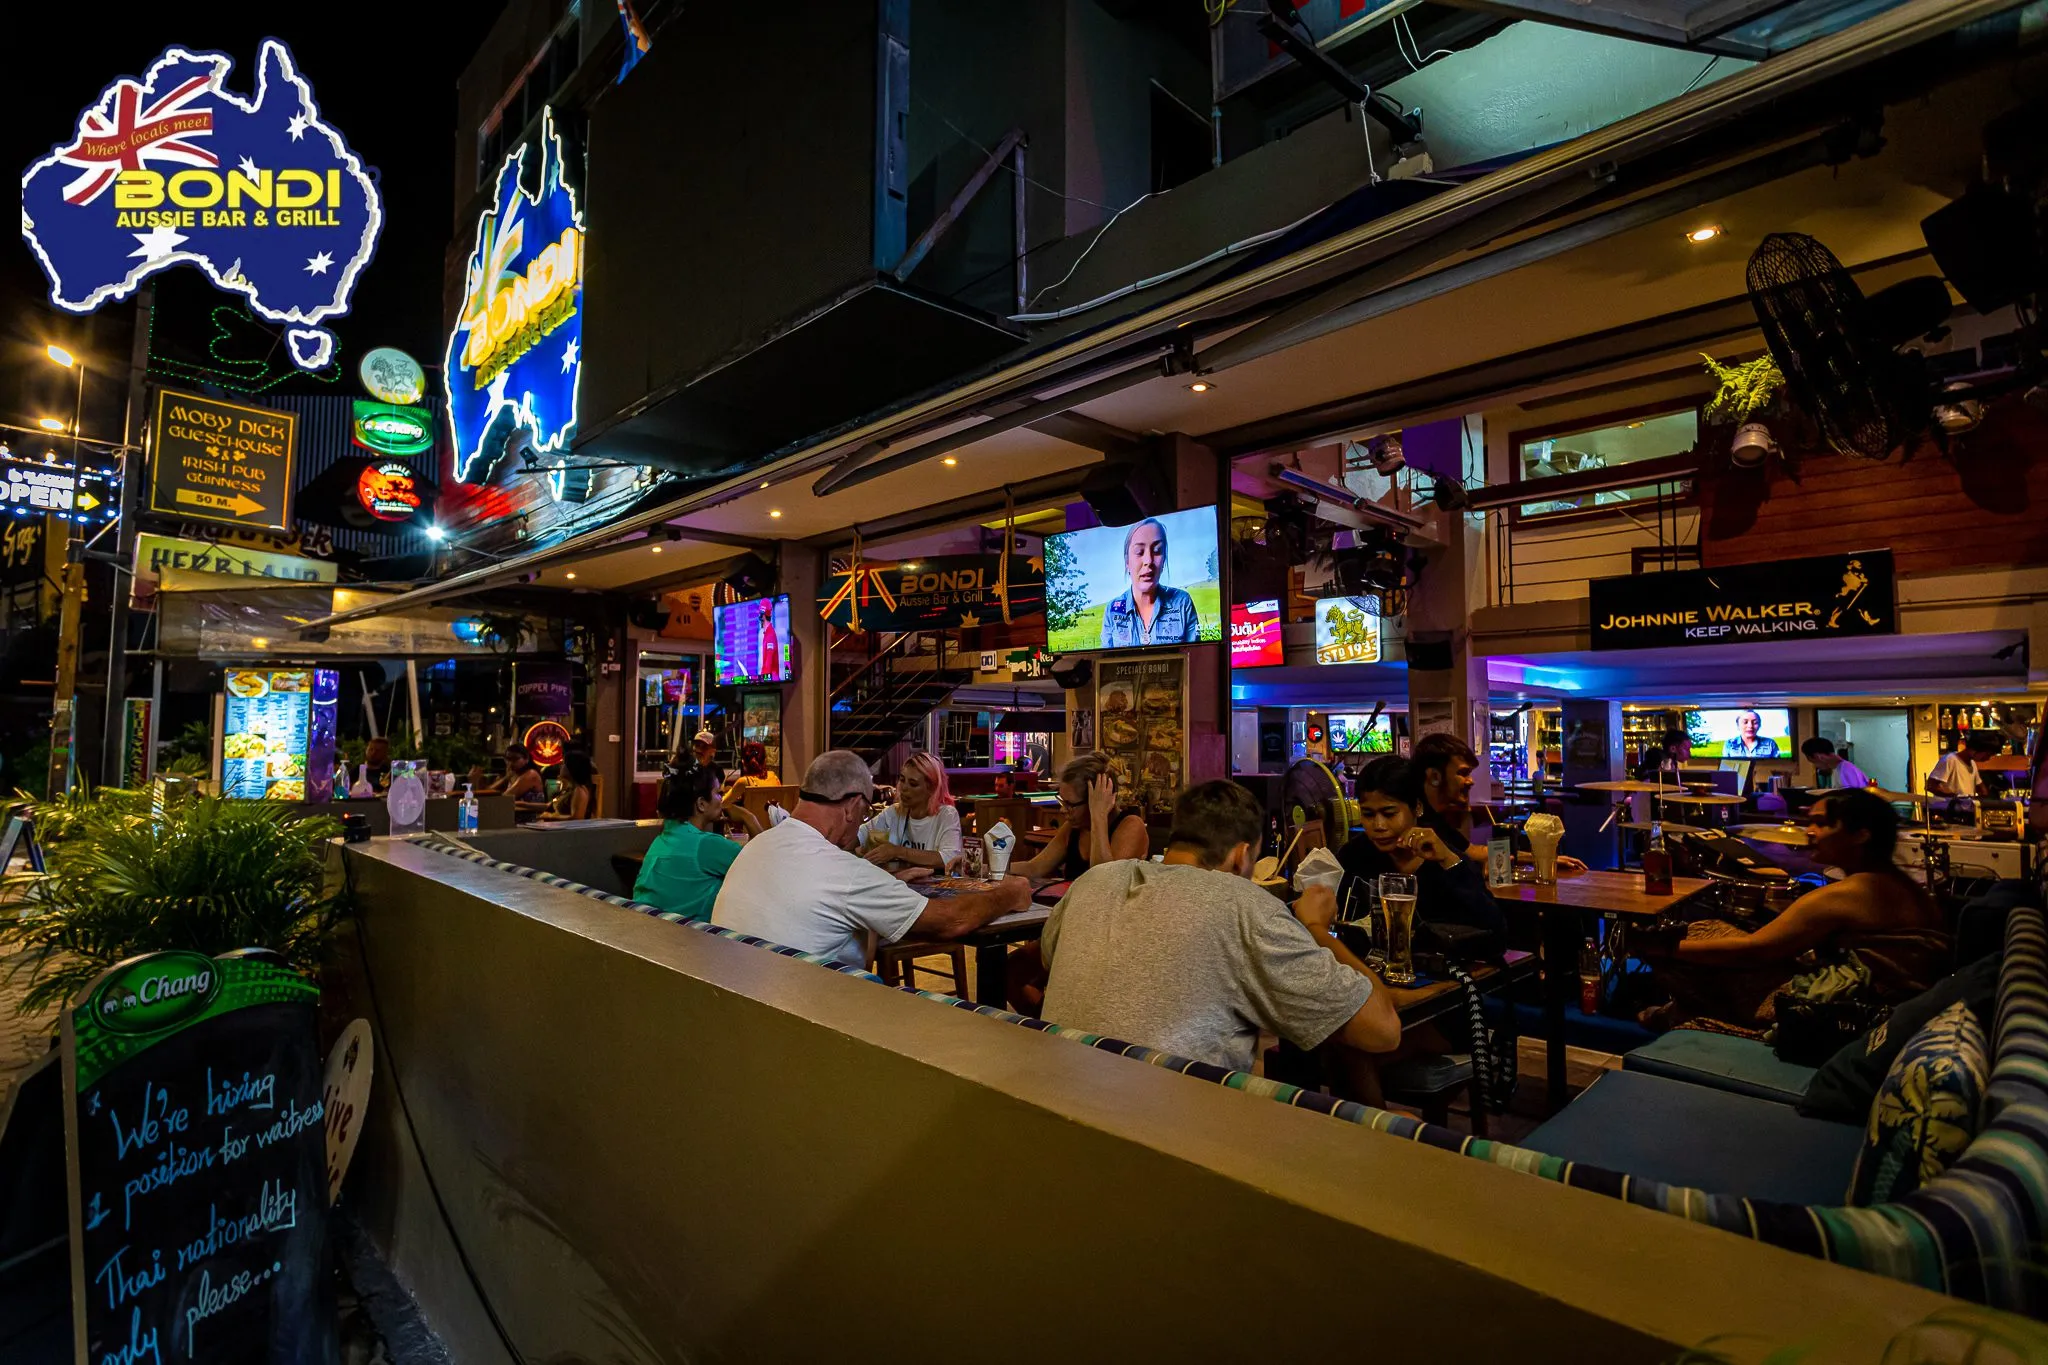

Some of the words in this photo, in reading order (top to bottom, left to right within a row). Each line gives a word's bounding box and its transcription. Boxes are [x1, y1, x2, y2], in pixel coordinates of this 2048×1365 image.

[83, 140, 127, 158] Where
[130, 119, 169, 147] locals
[174, 115, 209, 132] meet
[114, 169, 341, 209] BONDI
[116, 210, 195, 228] AUSSIE
[202, 210, 246, 227] BAR
[253, 210, 269, 227] &
[276, 209, 341, 227] GRILL
[469, 227, 578, 366] BONDI
[169, 406, 232, 433] MOBY
[239, 419, 285, 440] DICK
[168, 425, 284, 457] GUESTHOUSE
[182, 456, 226, 474] IRISH
[232, 465, 266, 481] PUB
[221, 450, 230, 461] &
[186, 472, 261, 493] GUINNESS
[195, 494, 213, 505] 50
[901, 567, 984, 594] BONDI
[899, 593, 930, 607] Aussie
[933, 592, 949, 605] Bar
[953, 592, 960, 604] &
[963, 589, 983, 603] Grill
[1600, 610, 1698, 630] JOHNNIE
[1685, 625, 1731, 638] KEEP
[1735, 619, 1819, 635] WALKING.
[1116, 664, 1147, 675] SPECIALS
[1148, 663, 1169, 673] BONDI
[518, 682, 548, 695] COPPER
[551, 683, 568, 696] PIPE
[139, 970, 211, 1004] Chang
[110, 1080, 189, 1161] We're
[207, 1066, 275, 1116] hiring
[125, 1142, 217, 1232] position
[257, 1098, 325, 1149] waitress
[95, 1245, 167, 1310] Thai
[178, 1178, 297, 1273] nationality
